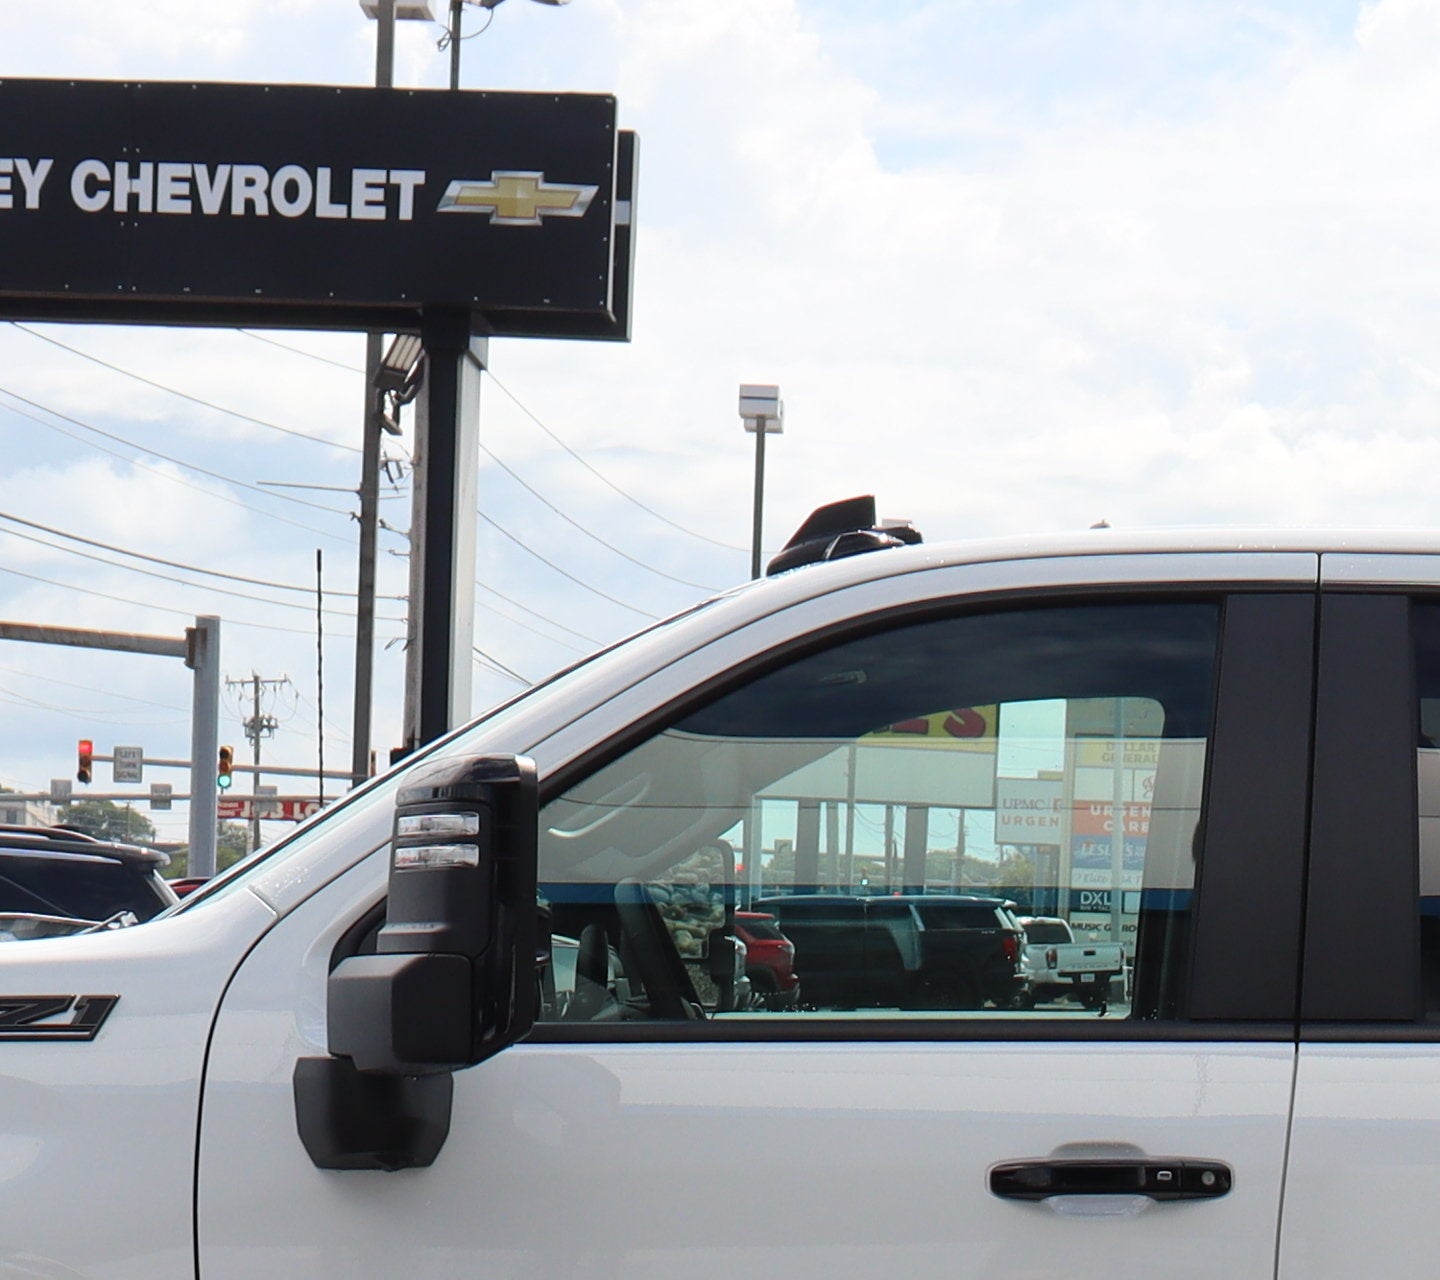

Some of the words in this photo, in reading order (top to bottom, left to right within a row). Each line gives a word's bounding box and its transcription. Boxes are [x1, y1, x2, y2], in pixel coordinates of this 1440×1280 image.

[70, 159, 426, 220] CHEVROLET
[1106, 742, 1156, 753] DLLAR
[1002, 815, 1060, 827] URGEN
[1080, 891, 1112, 905] DXL
[1070, 923, 1101, 932] MUSIC
